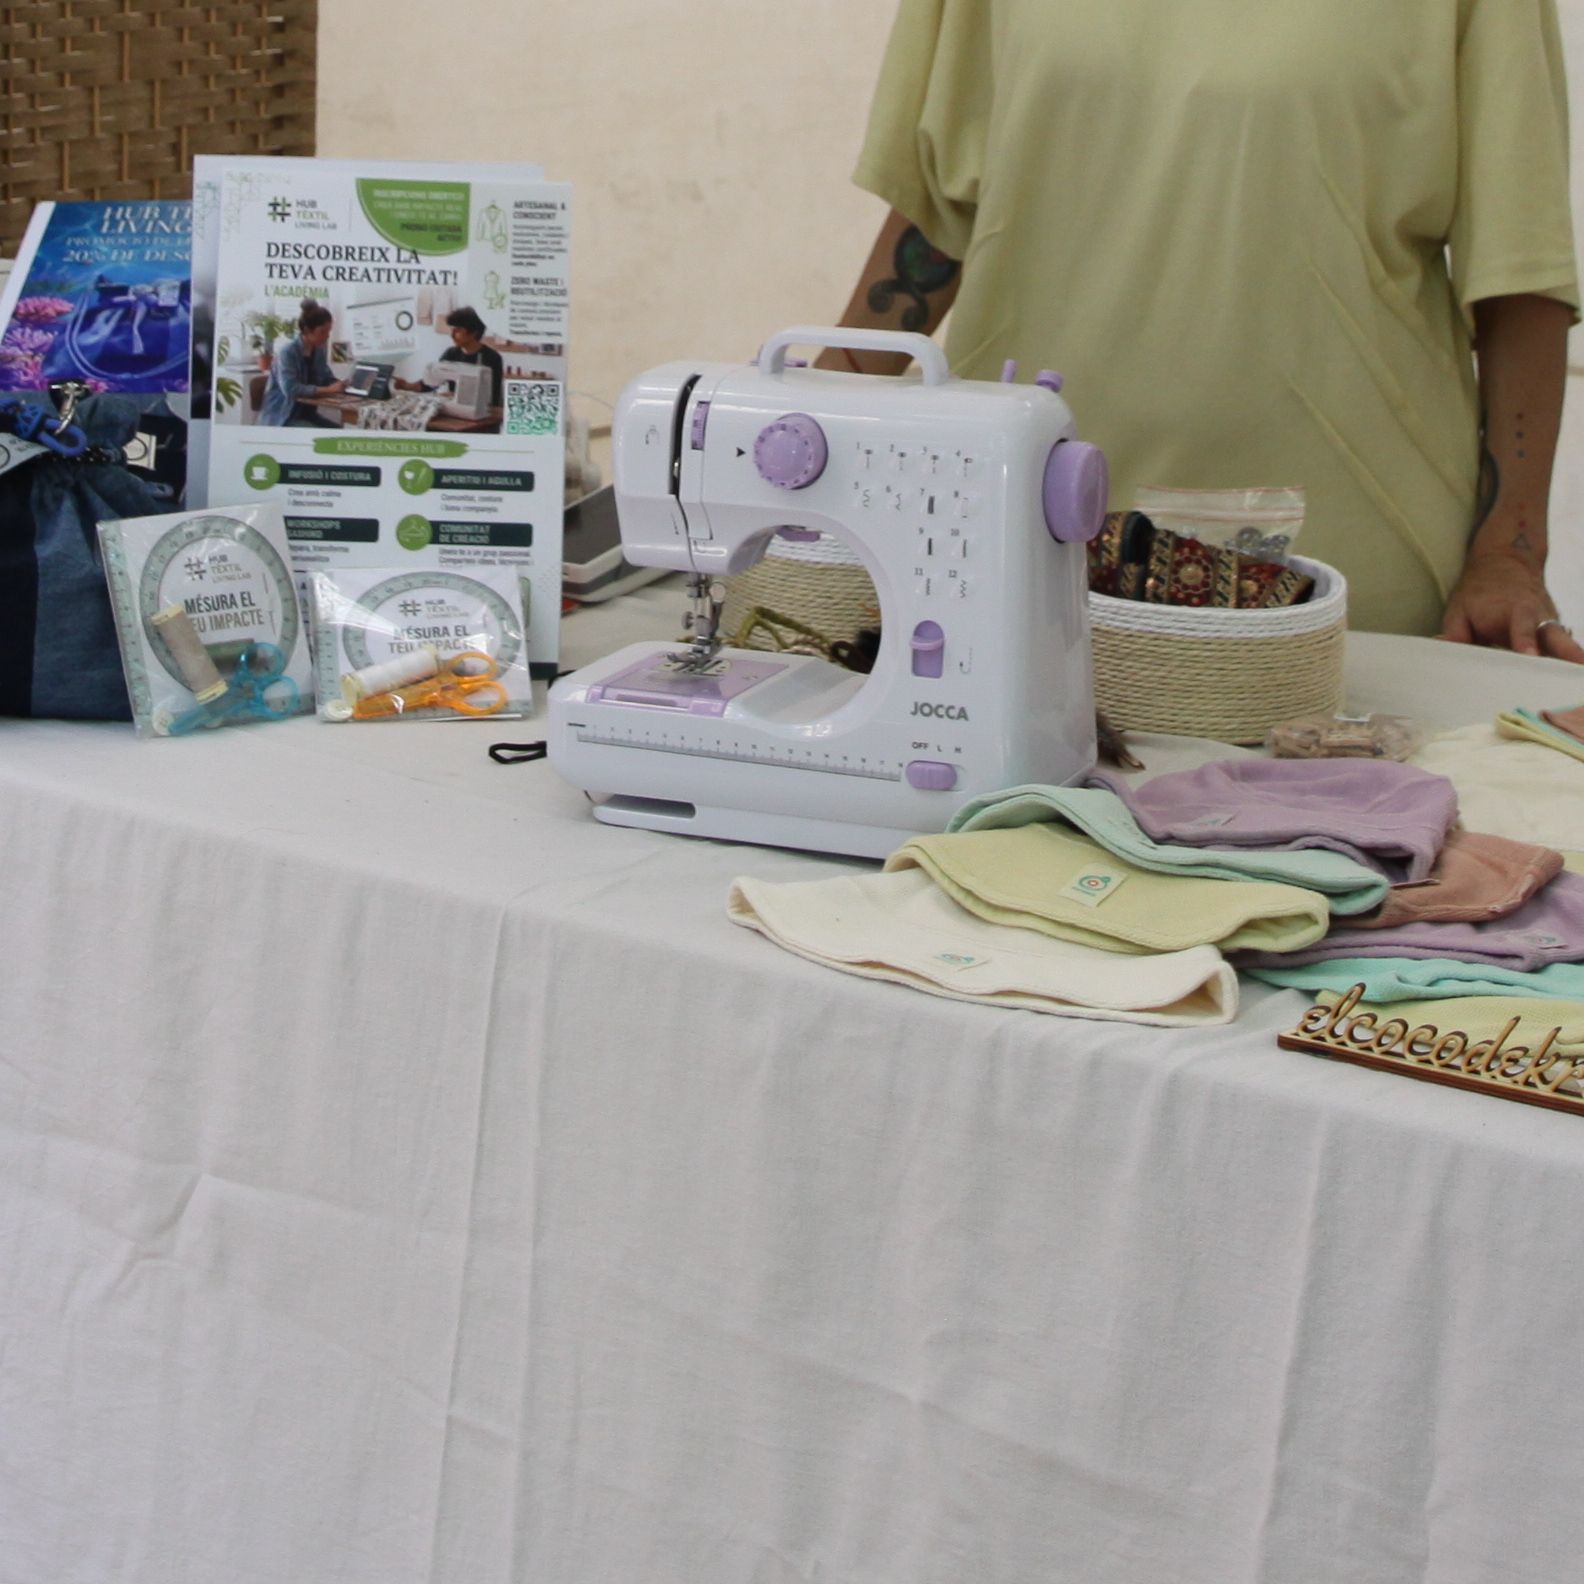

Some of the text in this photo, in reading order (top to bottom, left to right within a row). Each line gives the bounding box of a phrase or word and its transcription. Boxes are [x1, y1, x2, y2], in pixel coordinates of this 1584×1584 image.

[295, 199, 317, 209] HUB
[266, 242, 422, 264] DESCOBREIX LA
[264, 262, 459, 286] TEVA CREATIVITAT!
[184, 591, 256, 615] MÉSURA EL
[209, 610, 265, 631] IMPACTE
[454, 624, 471, 638] EL
[910, 701, 969, 721] JOCCA
[911, 741, 928, 750] OFF
